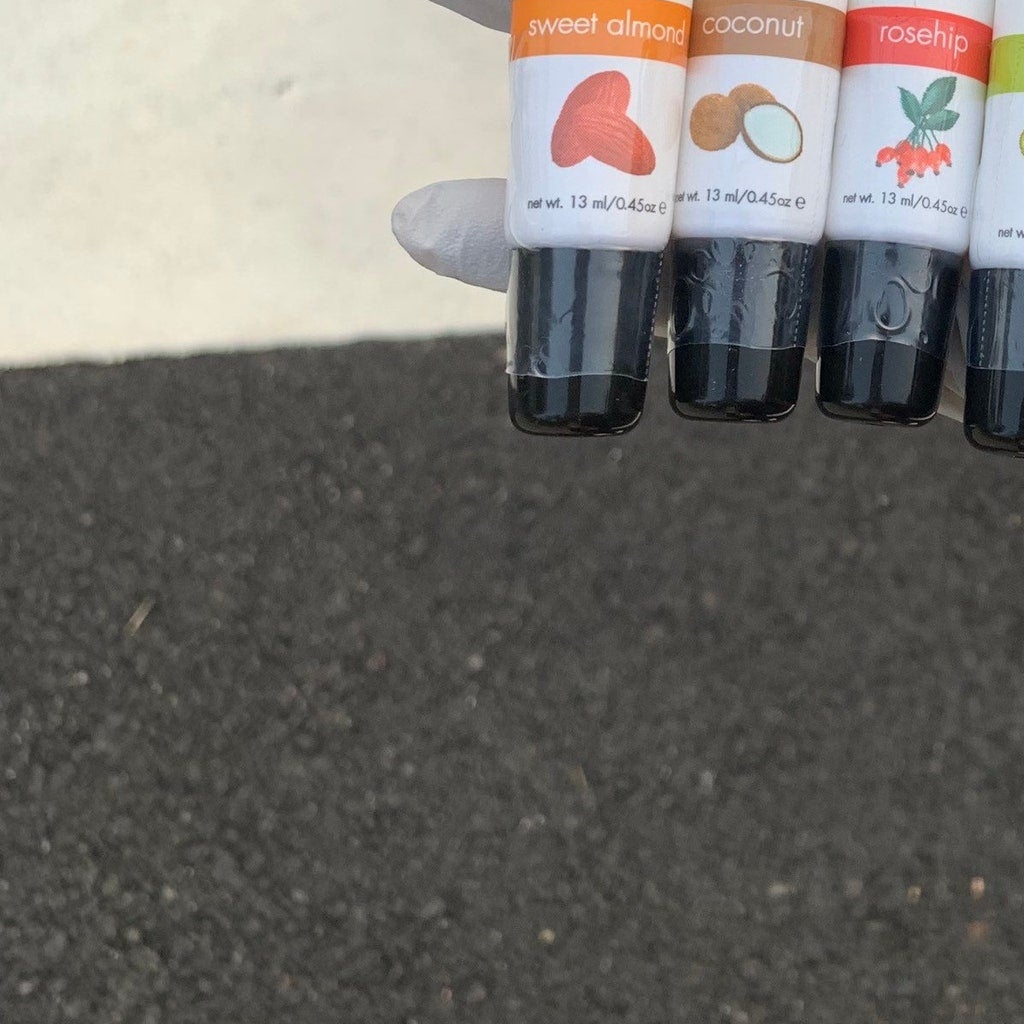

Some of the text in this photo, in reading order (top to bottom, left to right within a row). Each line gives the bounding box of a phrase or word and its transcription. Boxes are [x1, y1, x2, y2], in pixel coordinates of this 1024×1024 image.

[528, 10, 686, 47] sweet almond
[702, 15, 804, 38] coconut
[879, 20, 969, 59] rosehip
[527, 198, 543, 211] net
[570, 195, 587, 209] 13
[706, 188, 720, 202] 13
[843, 192, 857, 204] net
[881, 192, 897, 205] 13
[998, 226, 1012, 238] net
